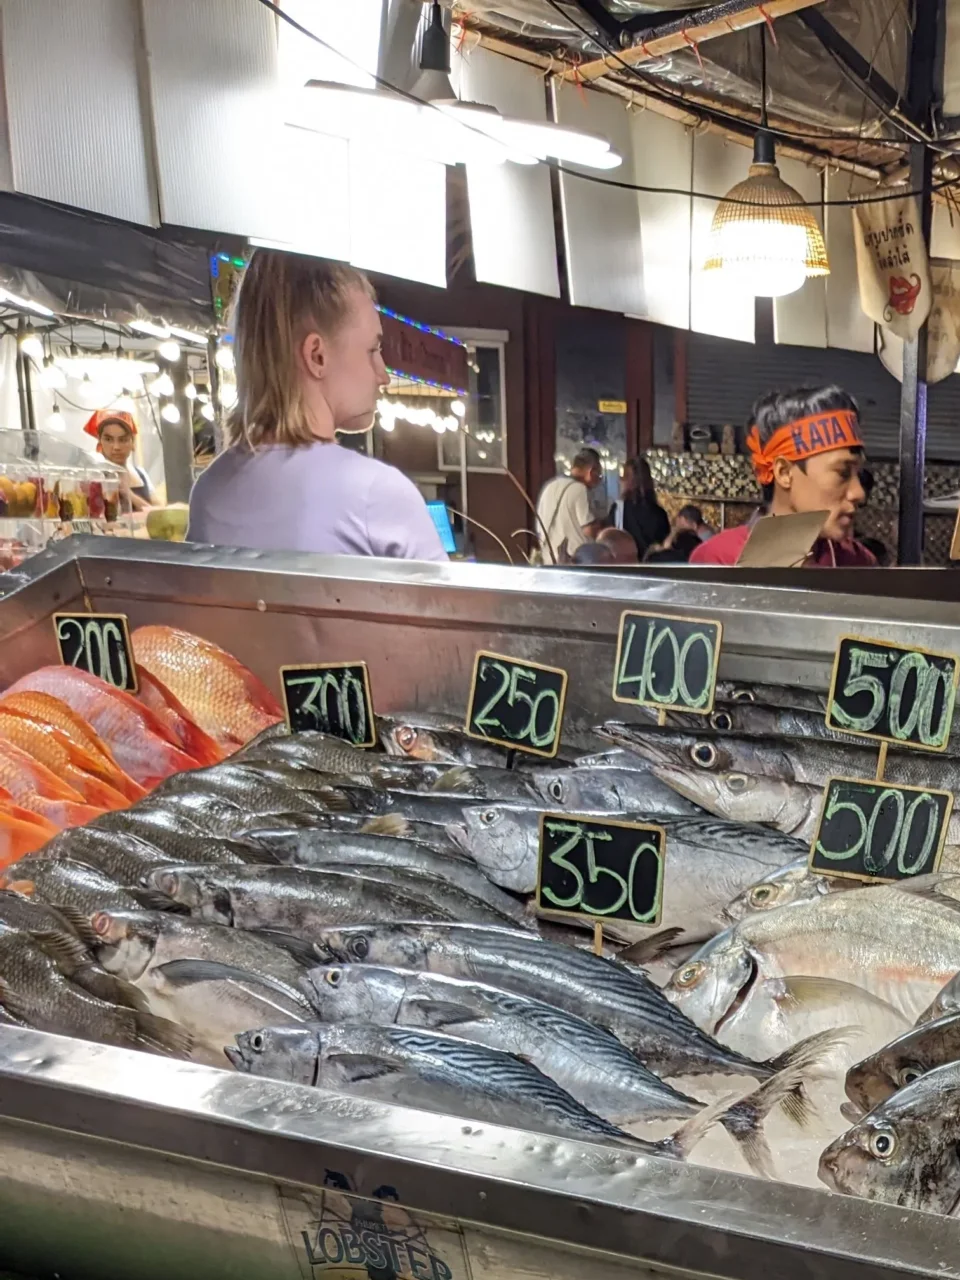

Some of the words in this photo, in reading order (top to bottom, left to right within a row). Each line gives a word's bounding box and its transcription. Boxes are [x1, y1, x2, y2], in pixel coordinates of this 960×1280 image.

[791, 416, 848, 455] KATA
[57, 618, 127, 690] 200
[618, 619, 715, 708] 400
[831, 647, 956, 747] 500
[474, 660, 559, 747] 250
[541, 821, 663, 923] 350
[815, 785, 939, 875] 500
